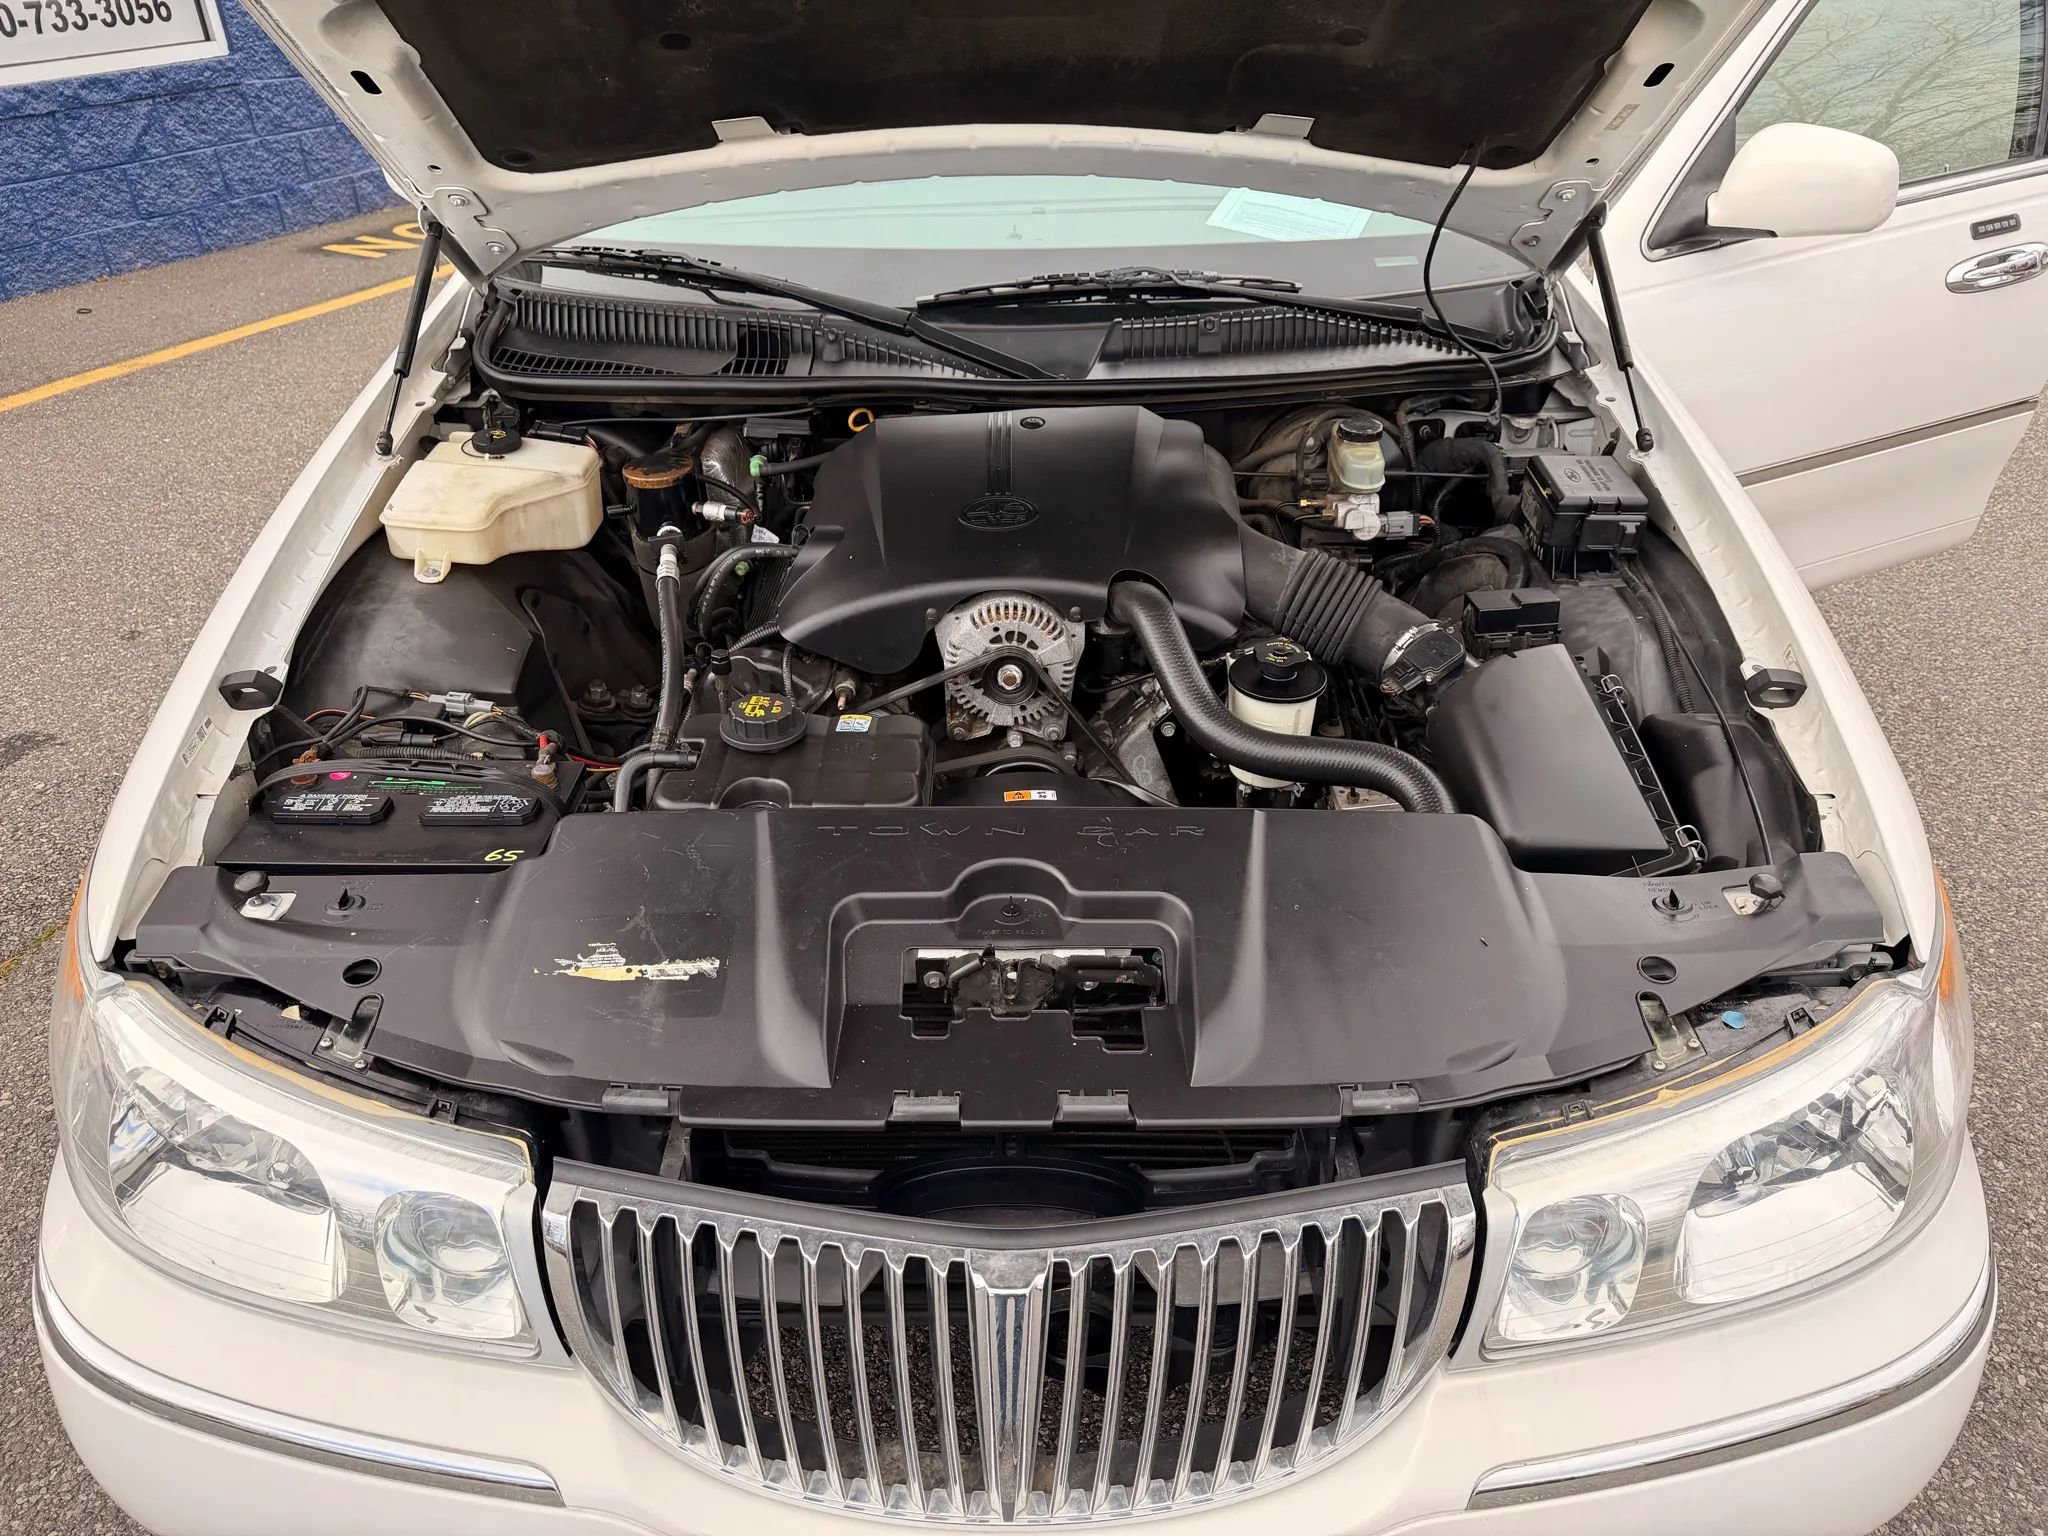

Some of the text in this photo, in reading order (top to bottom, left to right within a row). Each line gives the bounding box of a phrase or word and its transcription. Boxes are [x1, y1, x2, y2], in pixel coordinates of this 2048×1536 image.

[0, 0, 172, 38] 0-733-3056
[816, 825, 1206, 836] TOWN CAR
[484, 849, 525, 862] 65
